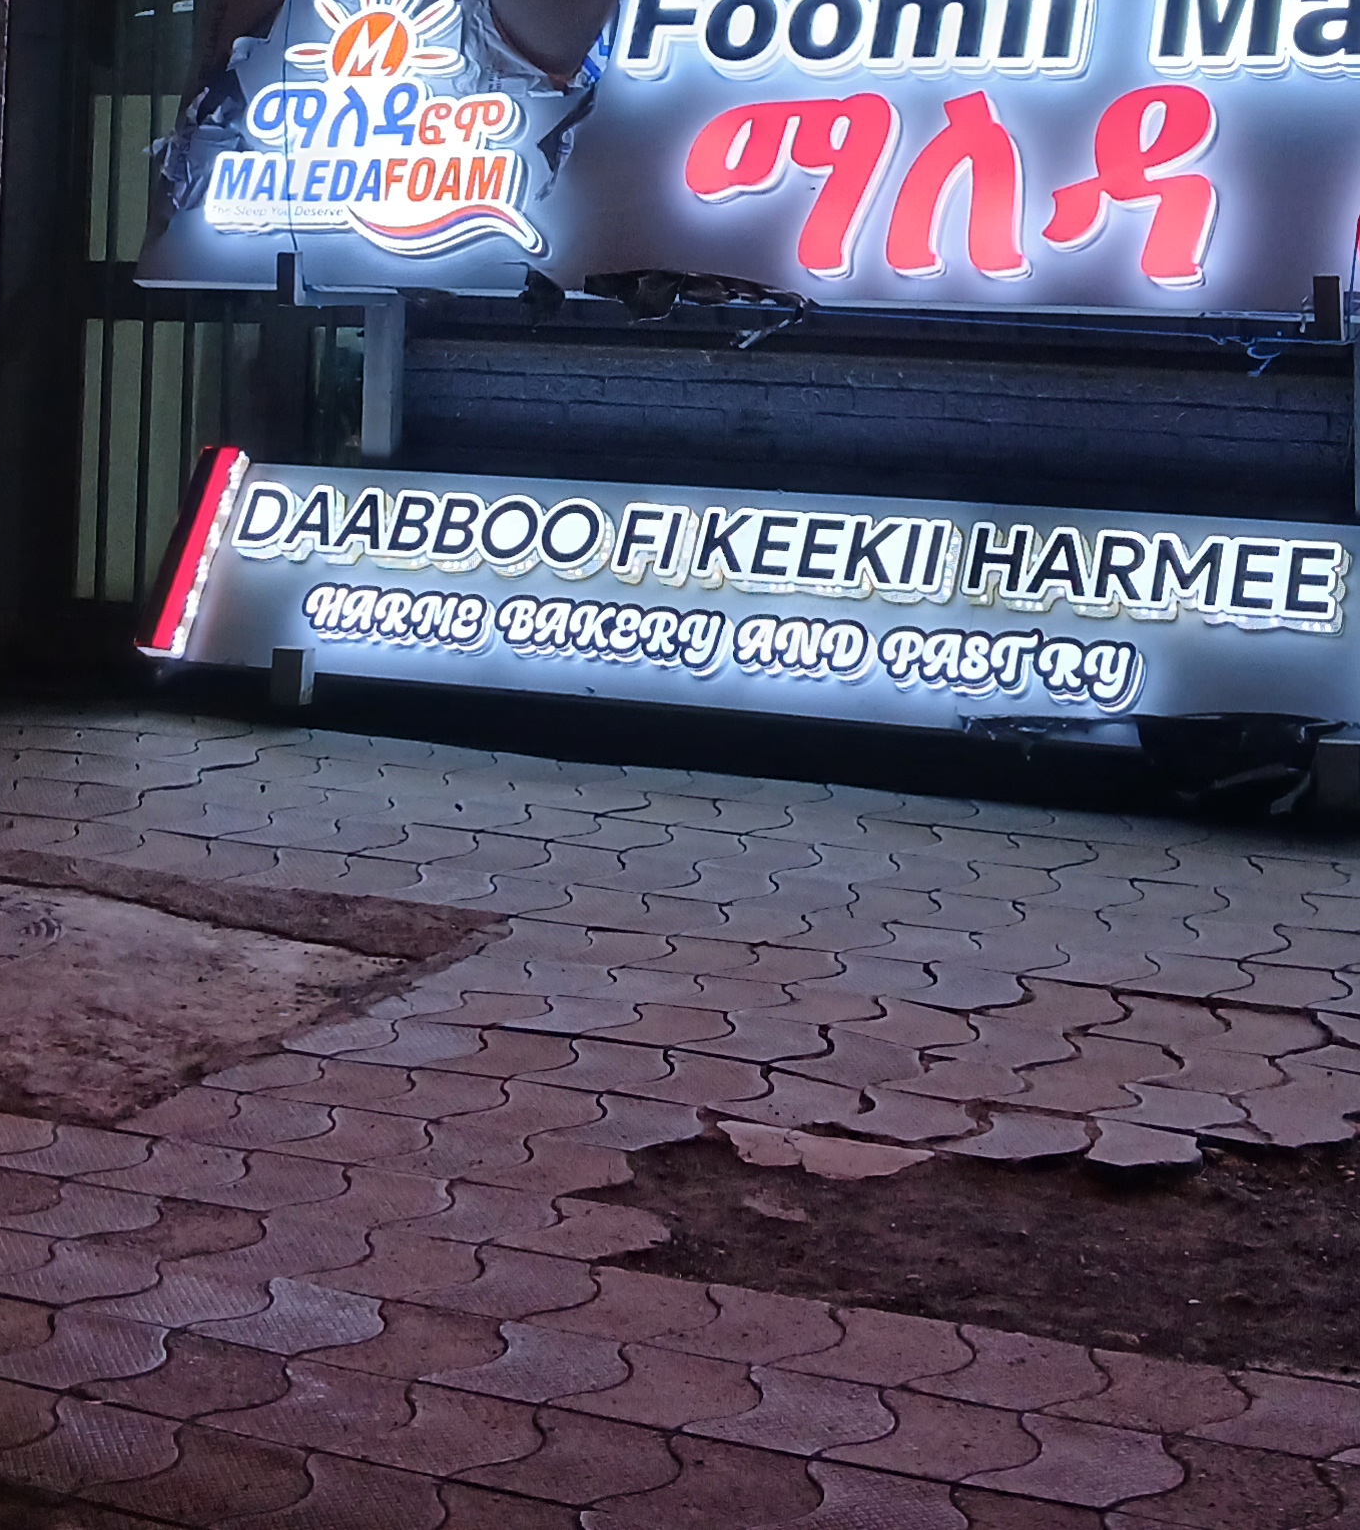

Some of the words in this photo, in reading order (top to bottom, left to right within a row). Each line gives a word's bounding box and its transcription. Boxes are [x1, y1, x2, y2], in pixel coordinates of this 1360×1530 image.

[215, 155, 507, 203] MALEDAFOAM
[294, 205, 344, 217] Deserve
[683, 84, 1220, 290] ማለዳ
[236, 486, 601, 564] DAABBOO
[616, 509, 684, 569] FI
[696, 511, 945, 594] KEEKII
[966, 527, 1340, 615] HARMEE
[496, 595, 726, 670] BAKERY
[739, 618, 866, 670] AND
[881, 628, 1139, 706] PASTRY
